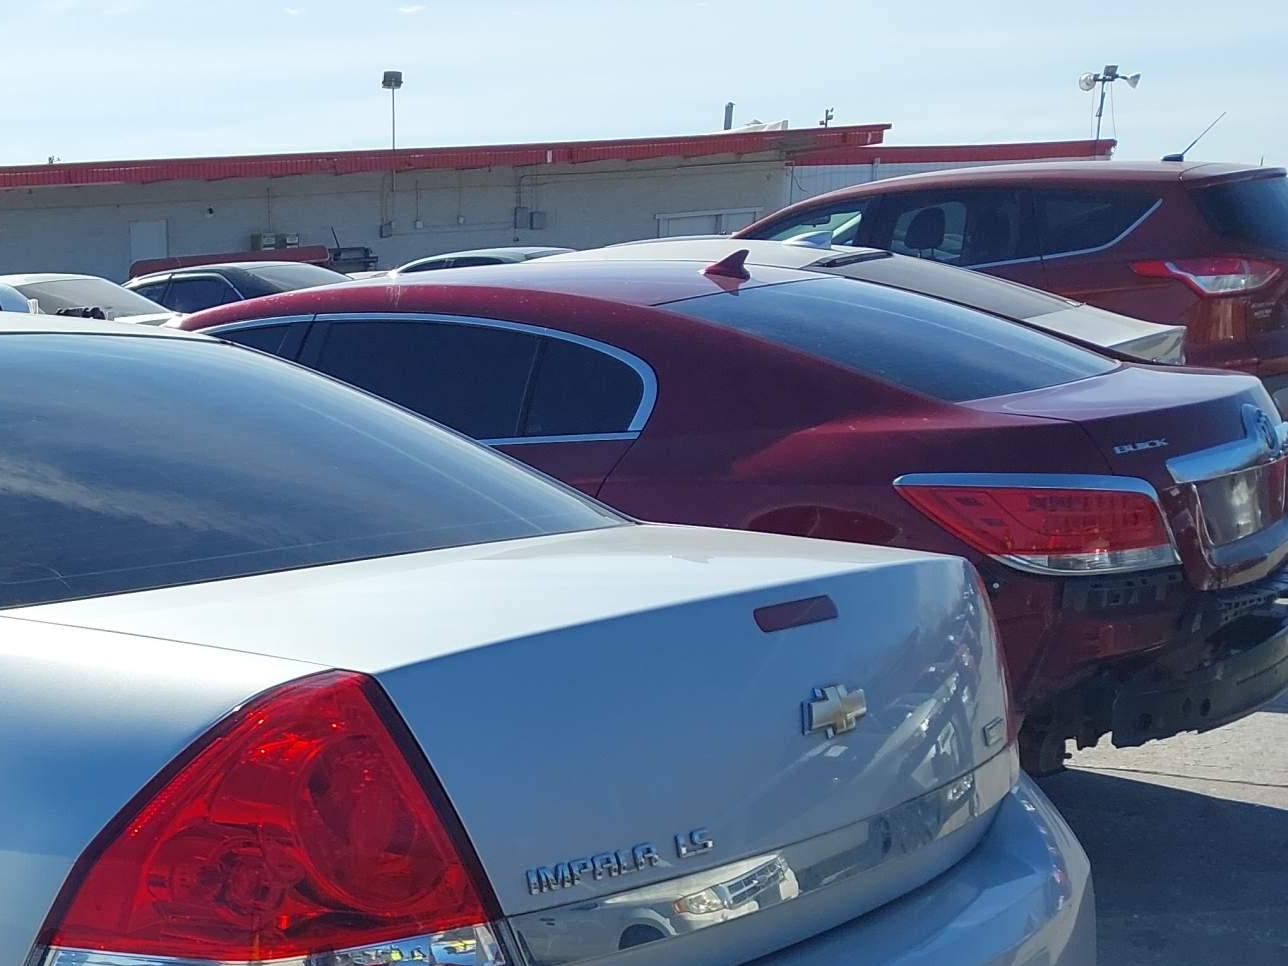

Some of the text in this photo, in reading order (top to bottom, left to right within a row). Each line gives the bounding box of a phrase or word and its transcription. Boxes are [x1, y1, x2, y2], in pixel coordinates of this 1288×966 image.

[1114, 438, 1168, 455] BUICK
[526, 827, 713, 896] IMPALA LS
